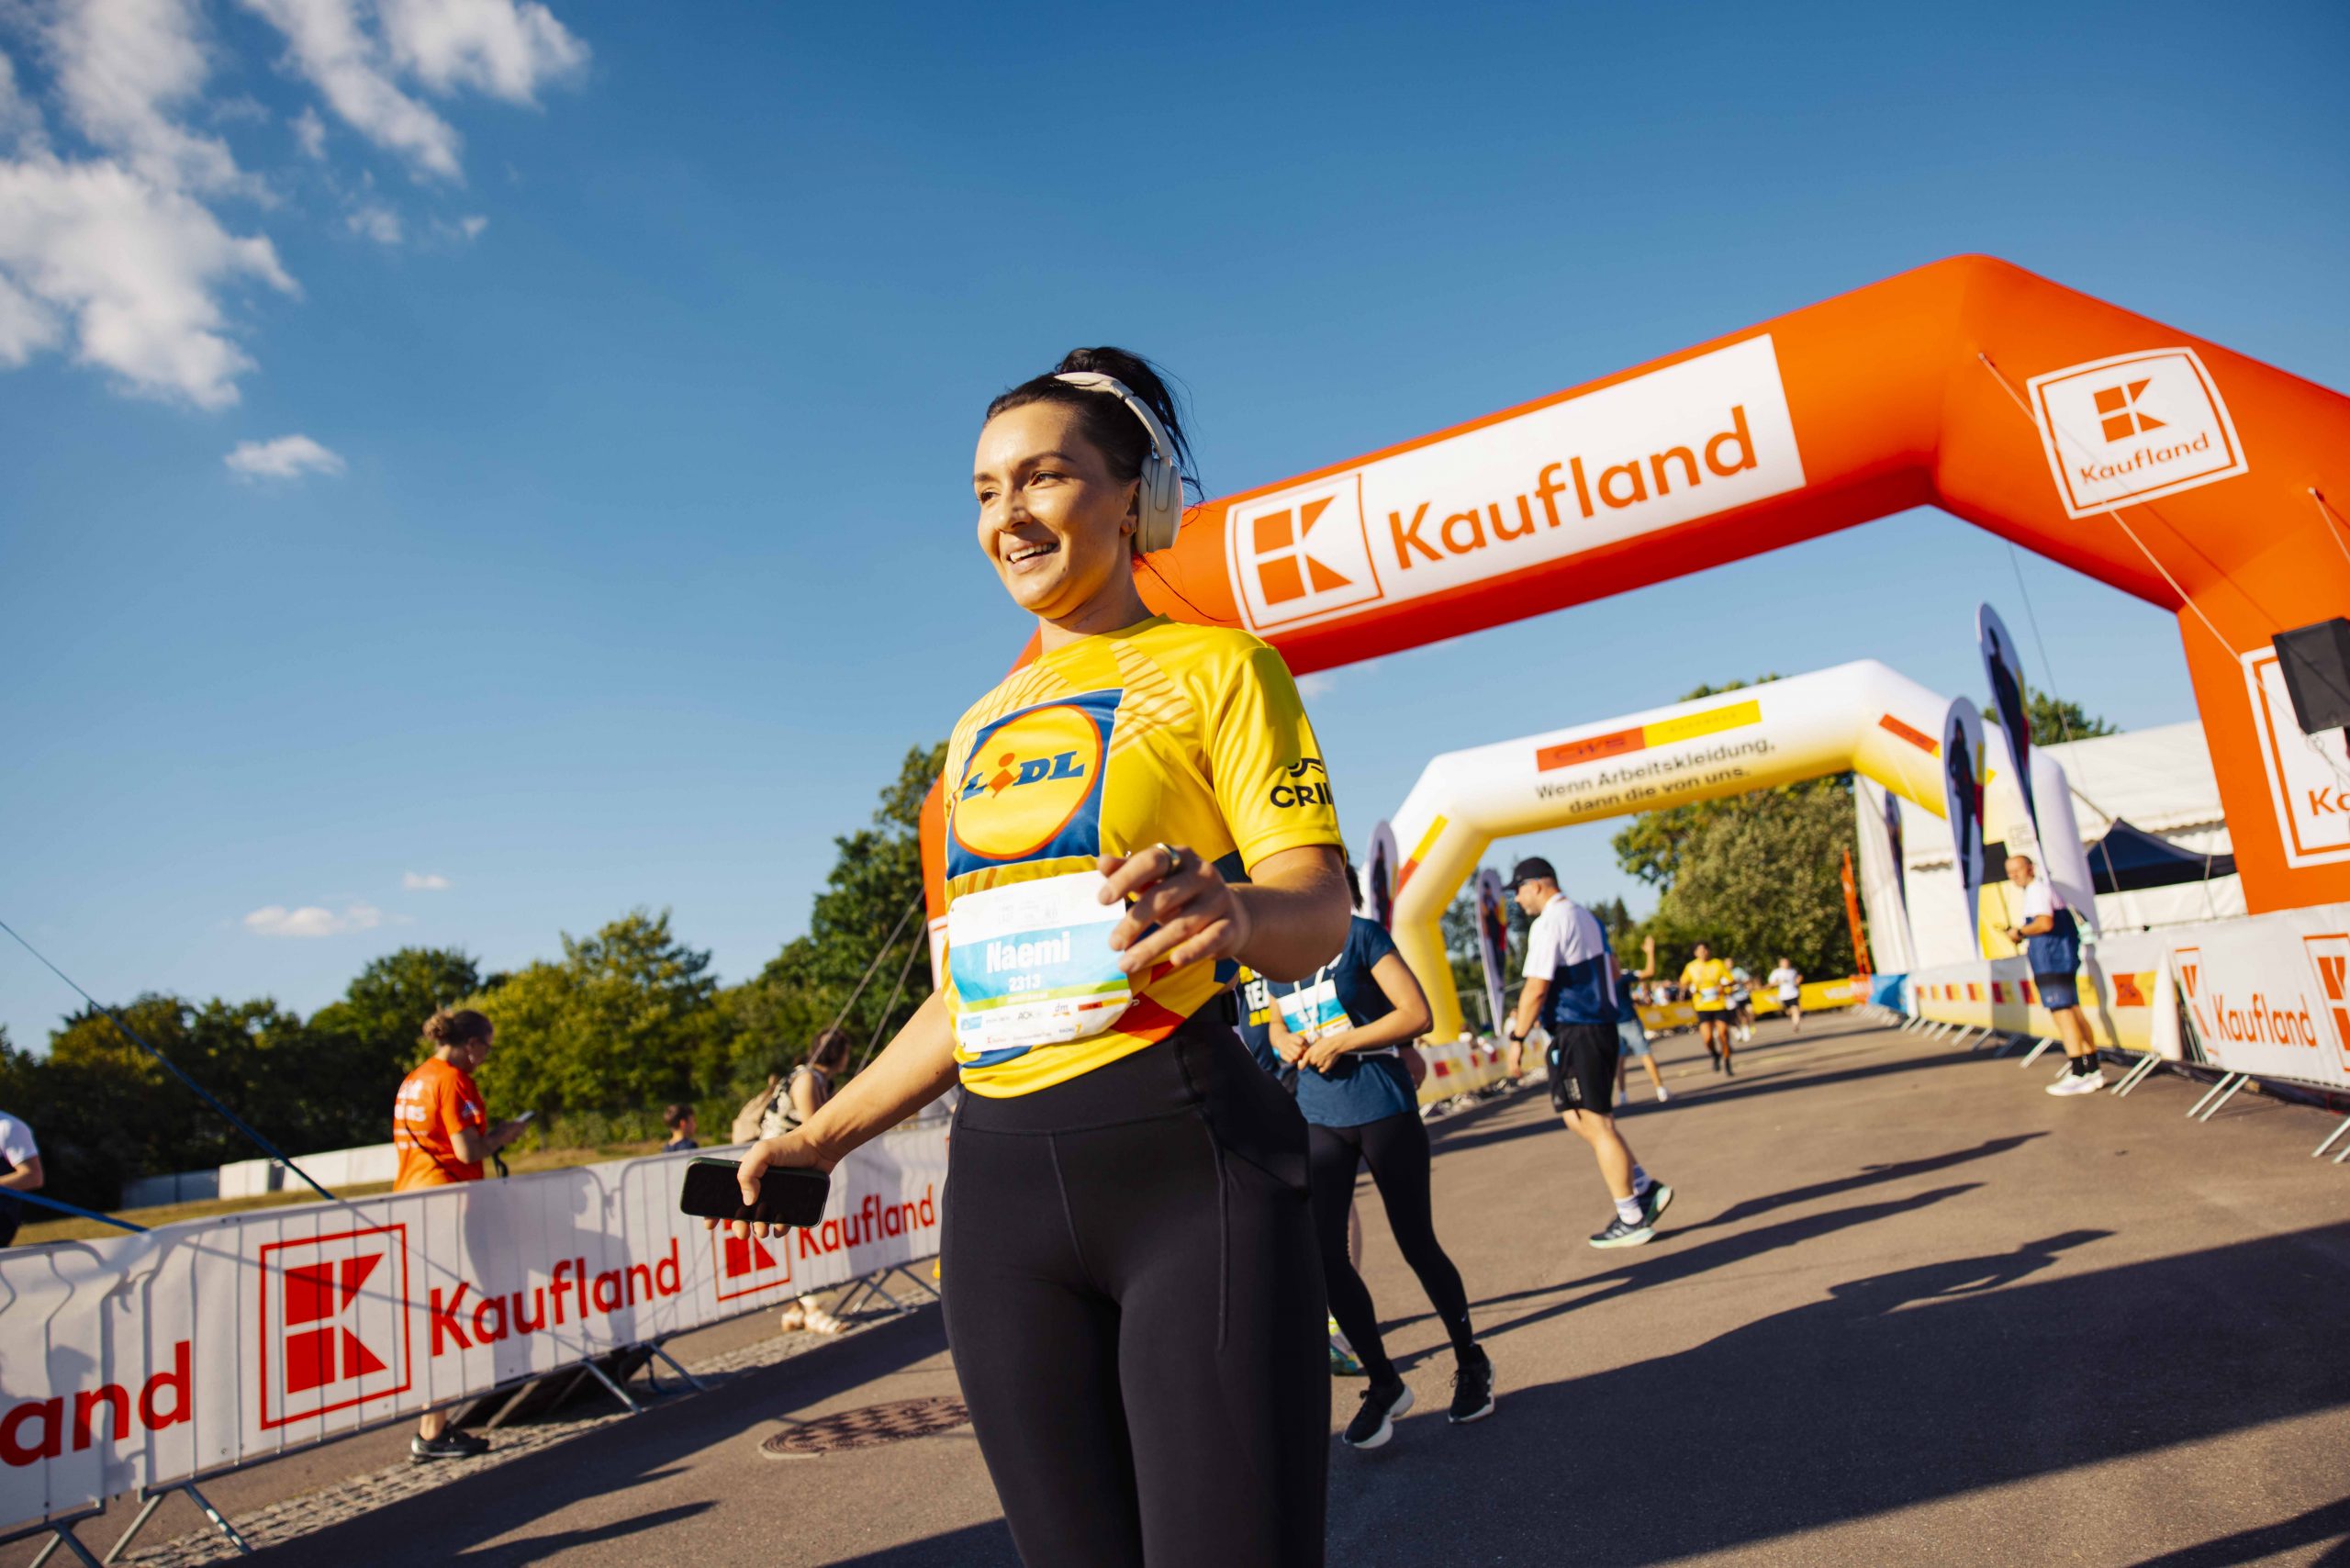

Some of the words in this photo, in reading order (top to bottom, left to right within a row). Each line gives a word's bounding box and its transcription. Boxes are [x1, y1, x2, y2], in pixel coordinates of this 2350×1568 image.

[2079, 432, 2210, 485] Kaufland
[1388, 405, 1758, 571] Kaufland
[1536, 775, 1593, 800] Wenn
[1568, 790, 1620, 814] dann
[1625, 784, 1657, 803] die
[1662, 776, 1700, 795] von
[1704, 766, 1751, 786] uns.
[986, 931, 1071, 974] Naemi
[2212, 992, 2318, 1048] Kaufland
[797, 1182, 935, 1260] Kaufland
[431, 1238, 682, 1357] Kaufland
